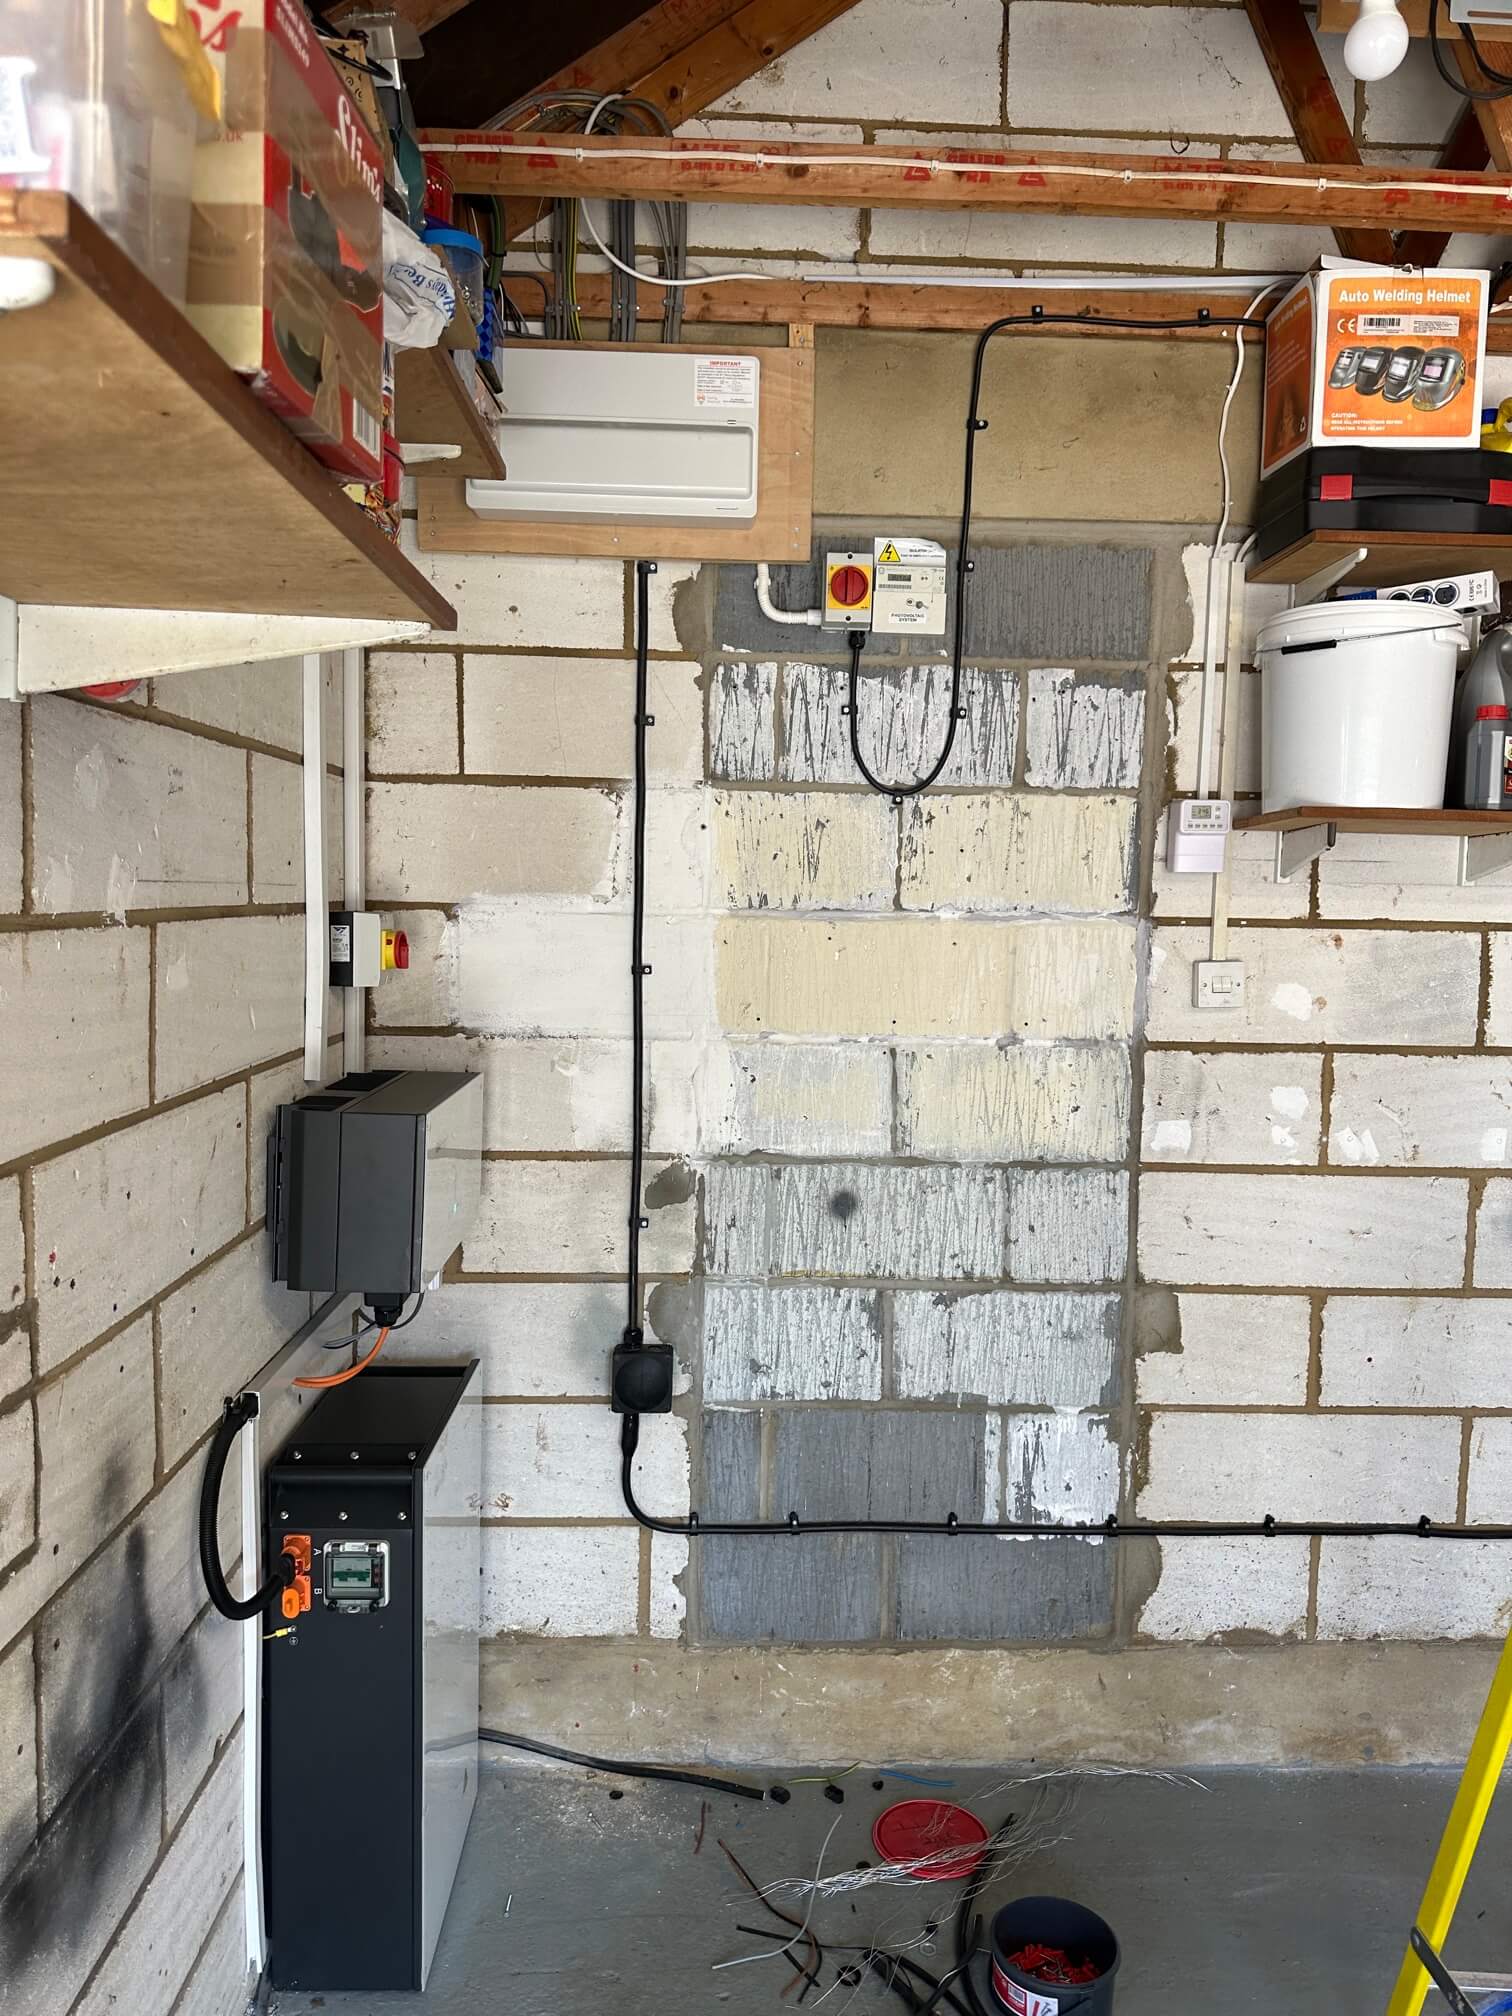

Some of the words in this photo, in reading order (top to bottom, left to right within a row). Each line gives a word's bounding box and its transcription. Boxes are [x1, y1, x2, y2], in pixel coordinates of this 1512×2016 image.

[1339, 290, 1369, 302] Auto
[1373, 289, 1423, 305] Welding
[1427, 290, 1471, 303] Helmet
[314, 1548, 322, 1556] A
